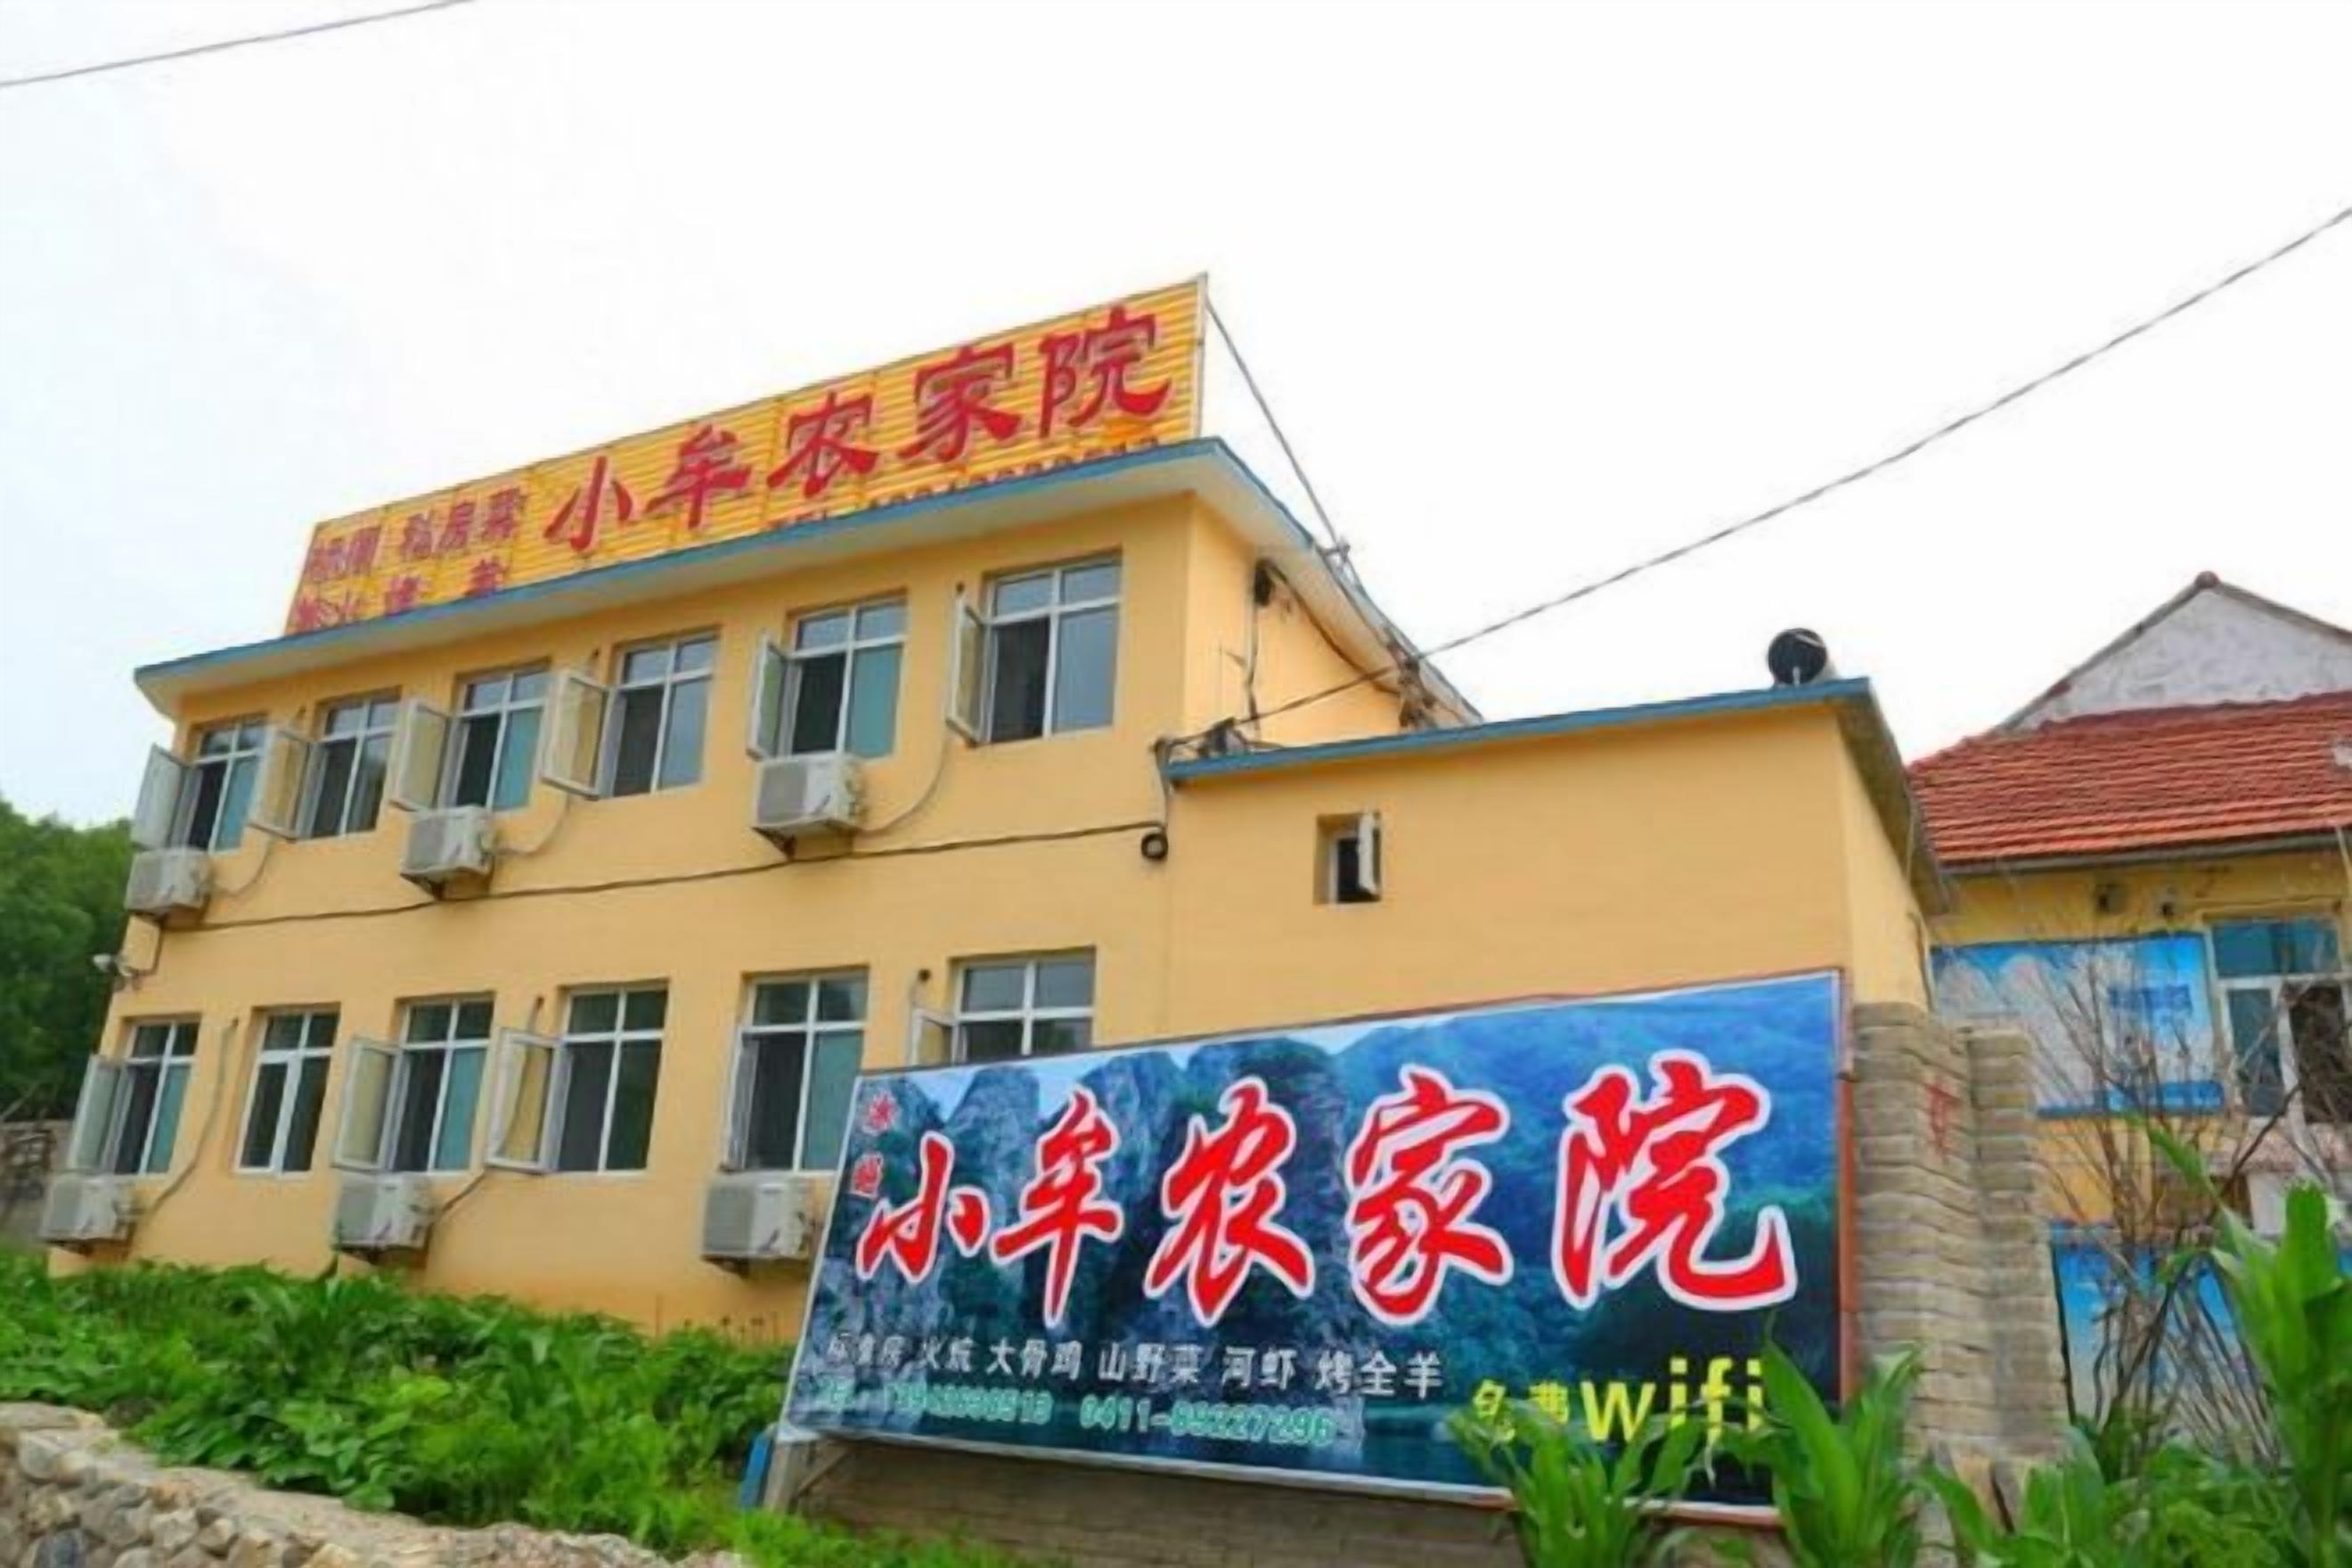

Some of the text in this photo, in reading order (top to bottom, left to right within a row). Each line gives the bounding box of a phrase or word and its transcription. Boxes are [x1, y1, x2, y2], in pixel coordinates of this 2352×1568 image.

[542, 306, 1172, 551] 小牟农家院
[855, 1049, 1798, 1327] 小牟农家院
[1098, 1341, 1203, 1383] 山野菜
[1314, 1350, 1444, 1400] 烤全羊
